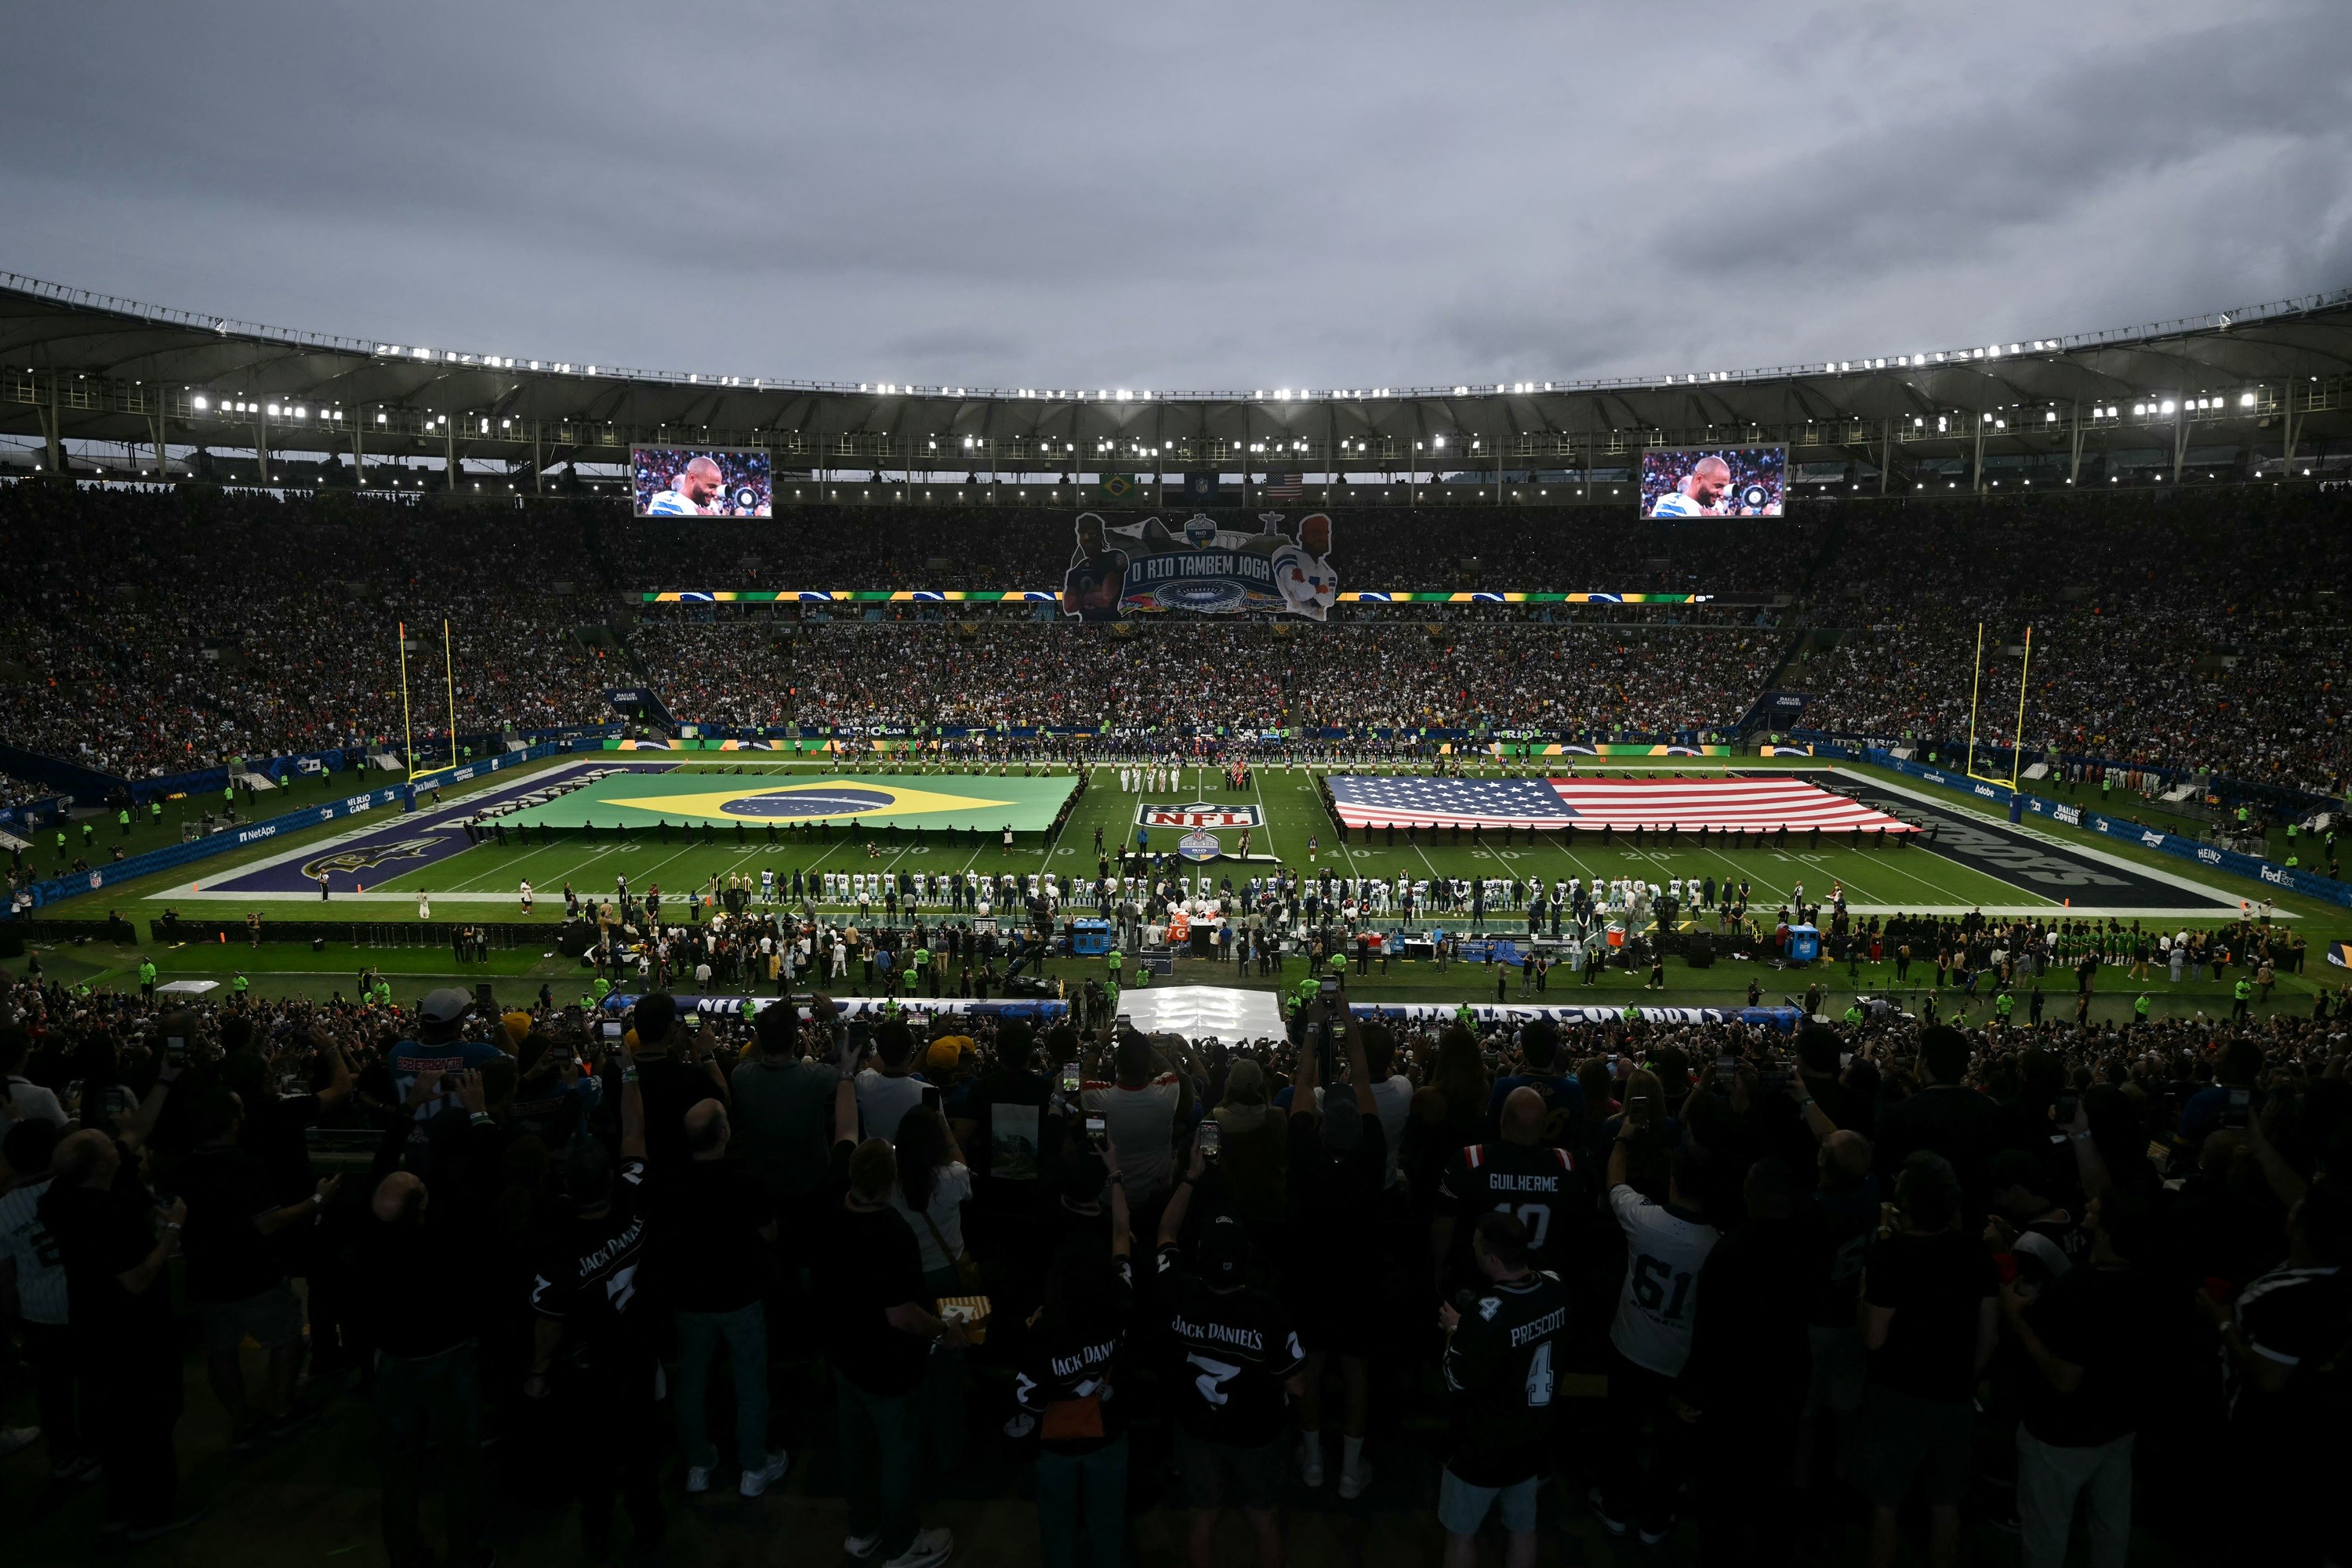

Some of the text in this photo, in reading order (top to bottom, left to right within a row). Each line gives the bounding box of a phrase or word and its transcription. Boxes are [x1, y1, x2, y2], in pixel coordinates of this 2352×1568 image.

[1132, 554, 1270, 583] O RIO TAMBÉM JOGA
[453, 768, 473, 778] AMERICAN
[457, 772, 474, 782] EXPRESS
[1923, 772, 1945, 784] accenture
[1974, 784, 1994, 798] Adobe
[356, 793, 371, 804] RIO
[350, 803, 371, 815] GAME
[2057, 804, 2079, 816] DALLAS
[1152, 813, 1250, 827] NFL
[2053, 811, 2079, 826] COWBOY
[248, 826, 276, 840] NetApp
[1194, 832, 1205, 840] NFL
[2198, 848, 2222, 864] HEINZ
[91, 877, 101, 887] NFL
[2260, 865, 2294, 887] FedEx
[1176, 927, 1185, 938] G
[697, 999, 740, 1013] NFL
[1404, 1004, 1543, 1022] DALAS
[1489, 1172, 1559, 1192] GUILHERME
[579, 1247, 611, 1277] JACK
[1632, 1254, 1693, 1319] 61
[1478, 1296, 1503, 1323] 4
[1171, 1313, 1264, 1352] JACK DANIEL'S
[1510, 1305, 1566, 1348] PRESCOTT
[1525, 1340, 1554, 1407] 4
